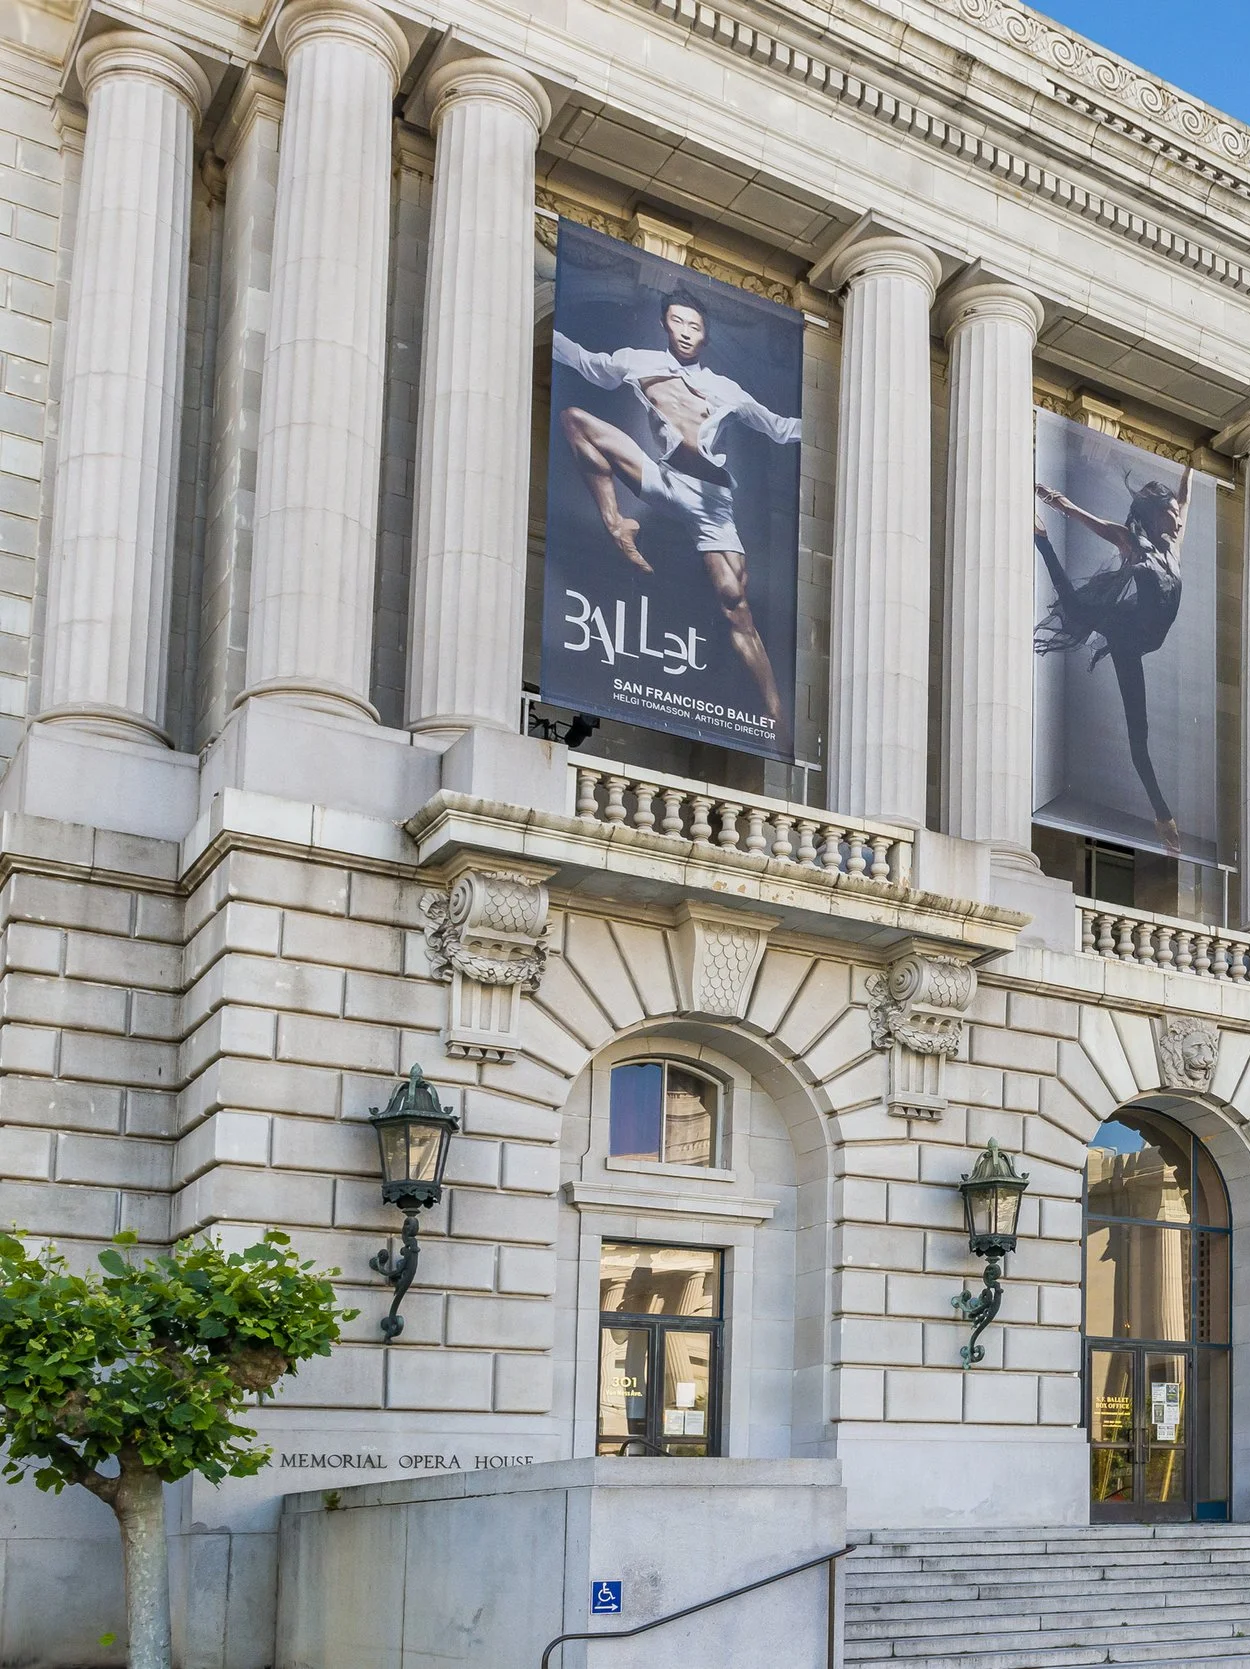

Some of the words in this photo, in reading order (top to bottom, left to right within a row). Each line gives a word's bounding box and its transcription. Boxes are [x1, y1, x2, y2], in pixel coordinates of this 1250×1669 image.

[613, 678, 643, 696] SAN
[646, 687, 724, 716] FRANCISCO
[727, 708, 776, 729] BALLET
[613, 692, 640, 706] HELGI
[695, 714, 733, 730] ARTISTIC
[734, 724, 776, 740] DIRECTOR
[611, 1376, 637, 1388] 301
[280, 1453, 388, 1470] MEMORIAL
[398, 1454, 462, 1470] OPERA
